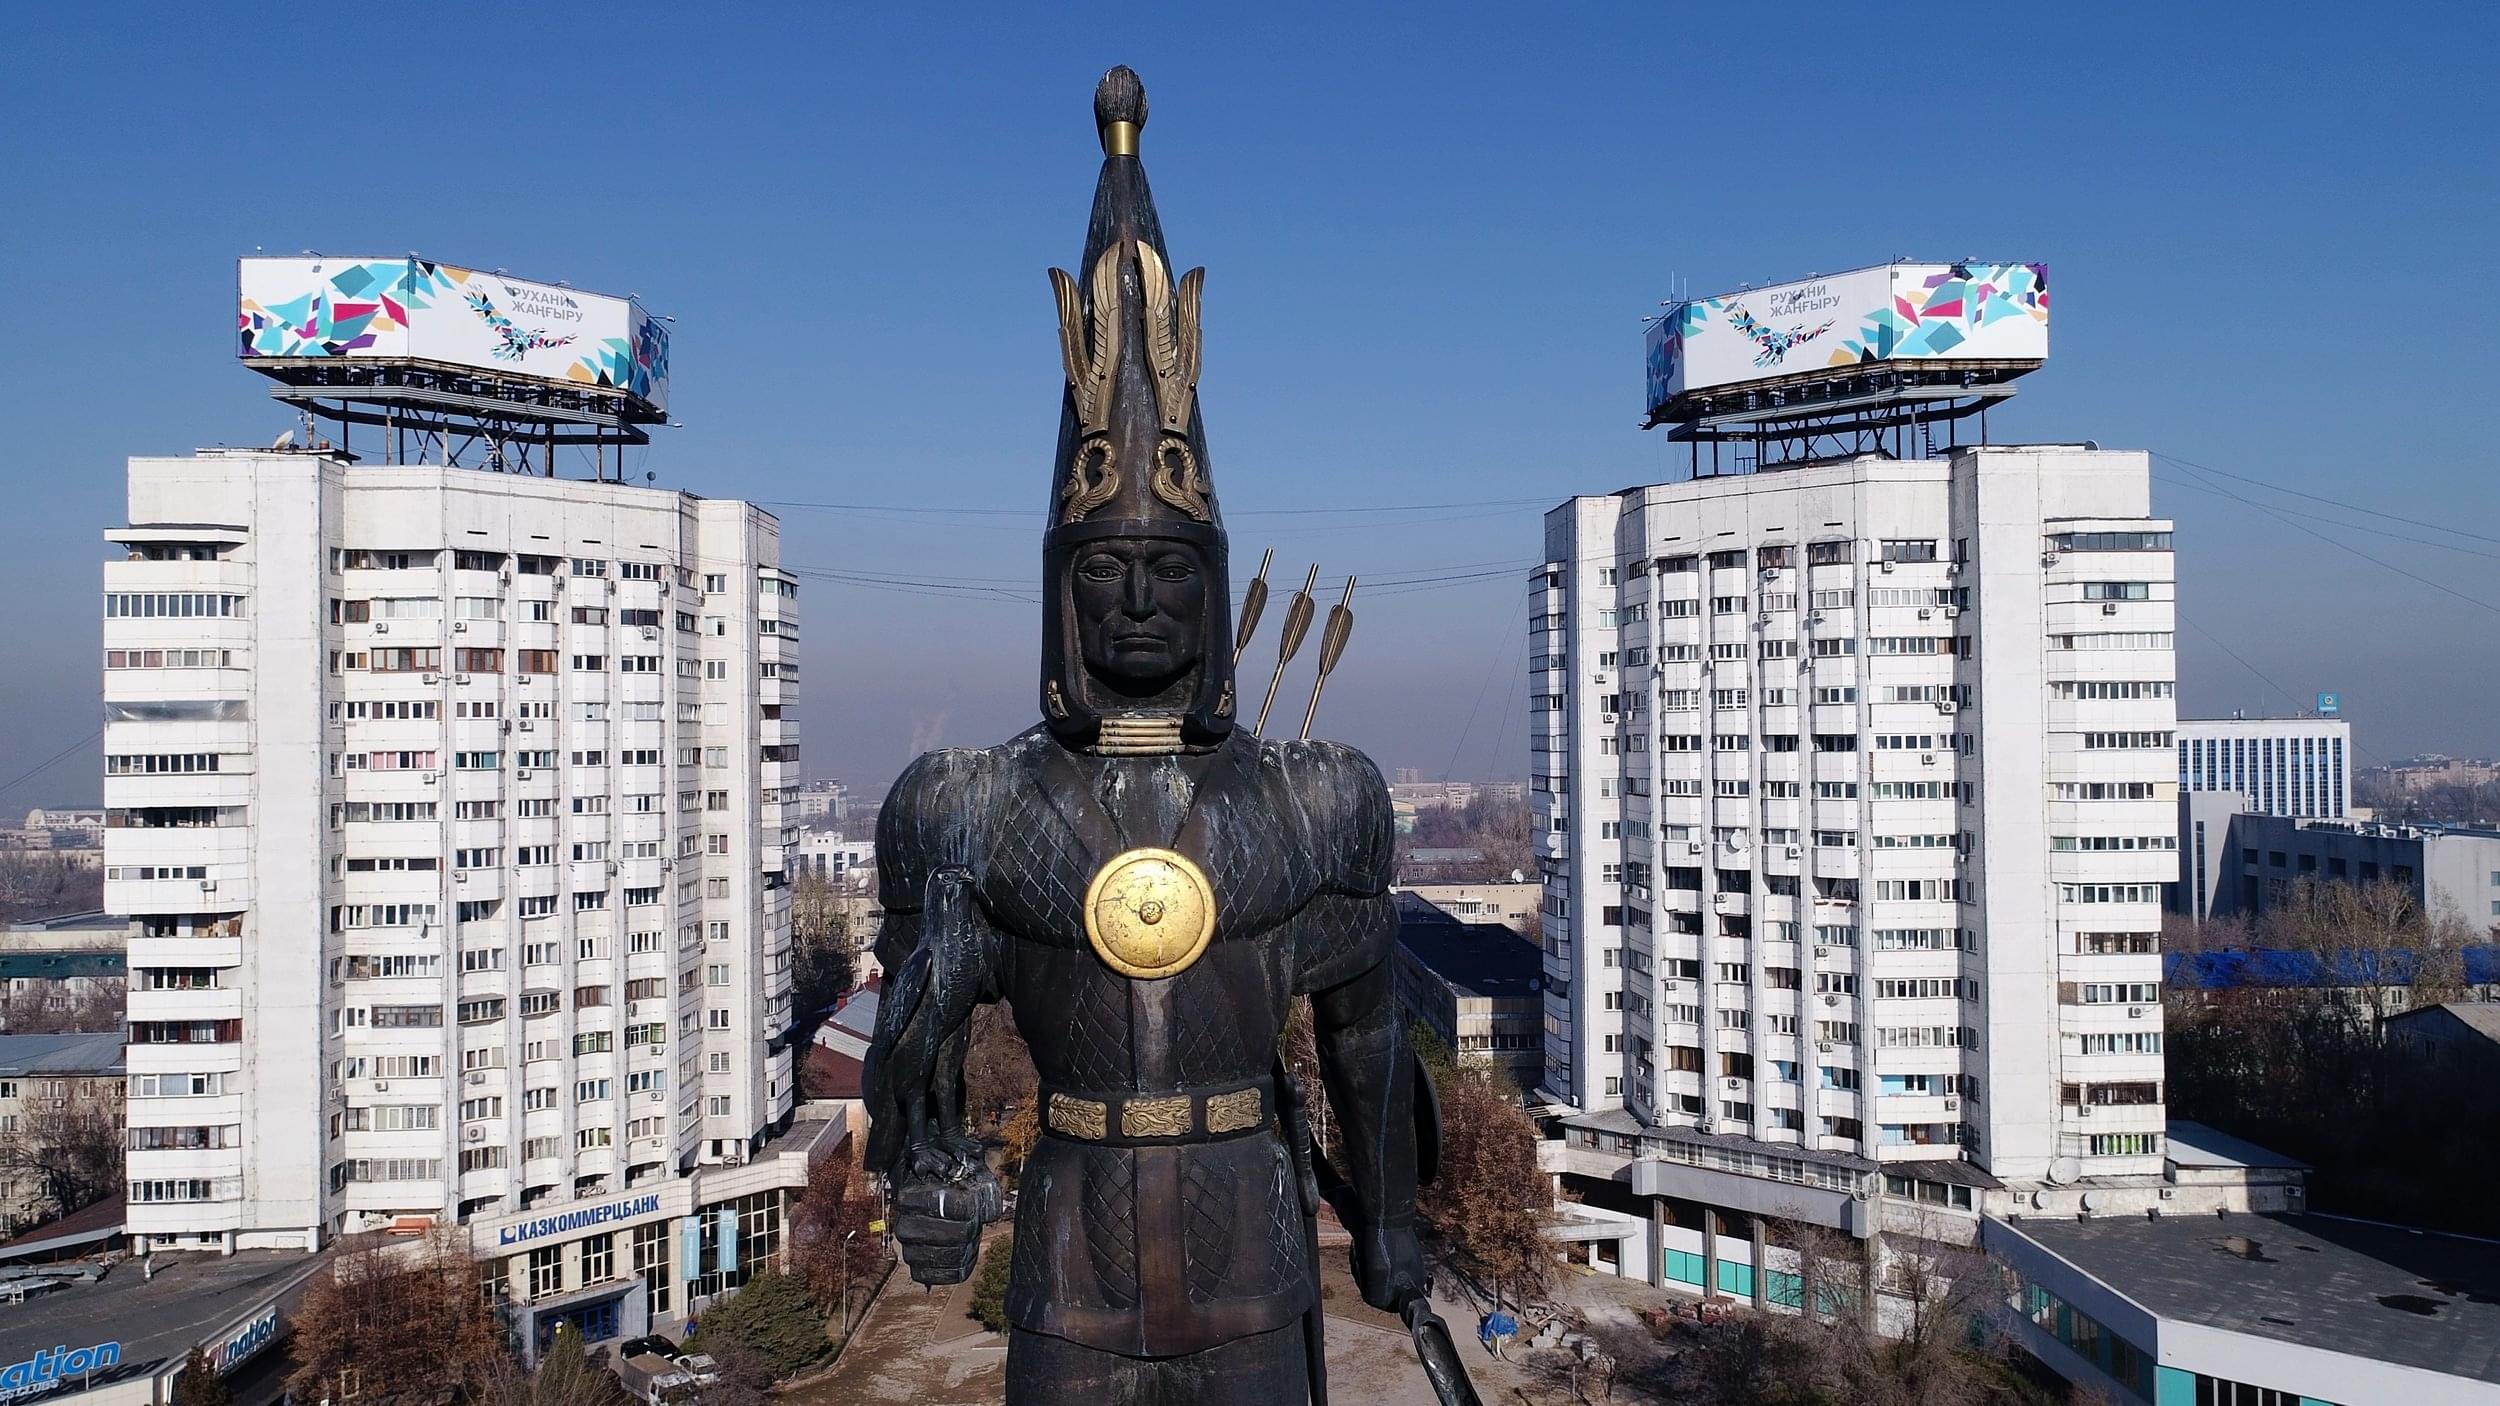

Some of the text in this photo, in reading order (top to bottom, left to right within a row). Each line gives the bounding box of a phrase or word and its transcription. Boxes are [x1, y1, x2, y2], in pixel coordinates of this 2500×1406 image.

[512, 287, 570, 307] РУХАНИ
[1770, 285, 1826, 305] РУХАНИ
[512, 300, 583, 322] ЖАҢҒЫРУ
[1770, 296, 1841, 318] ЖАҢҒЫРУ
[518, 1194, 660, 1240] КАЗКОММЕРЦБАНК
